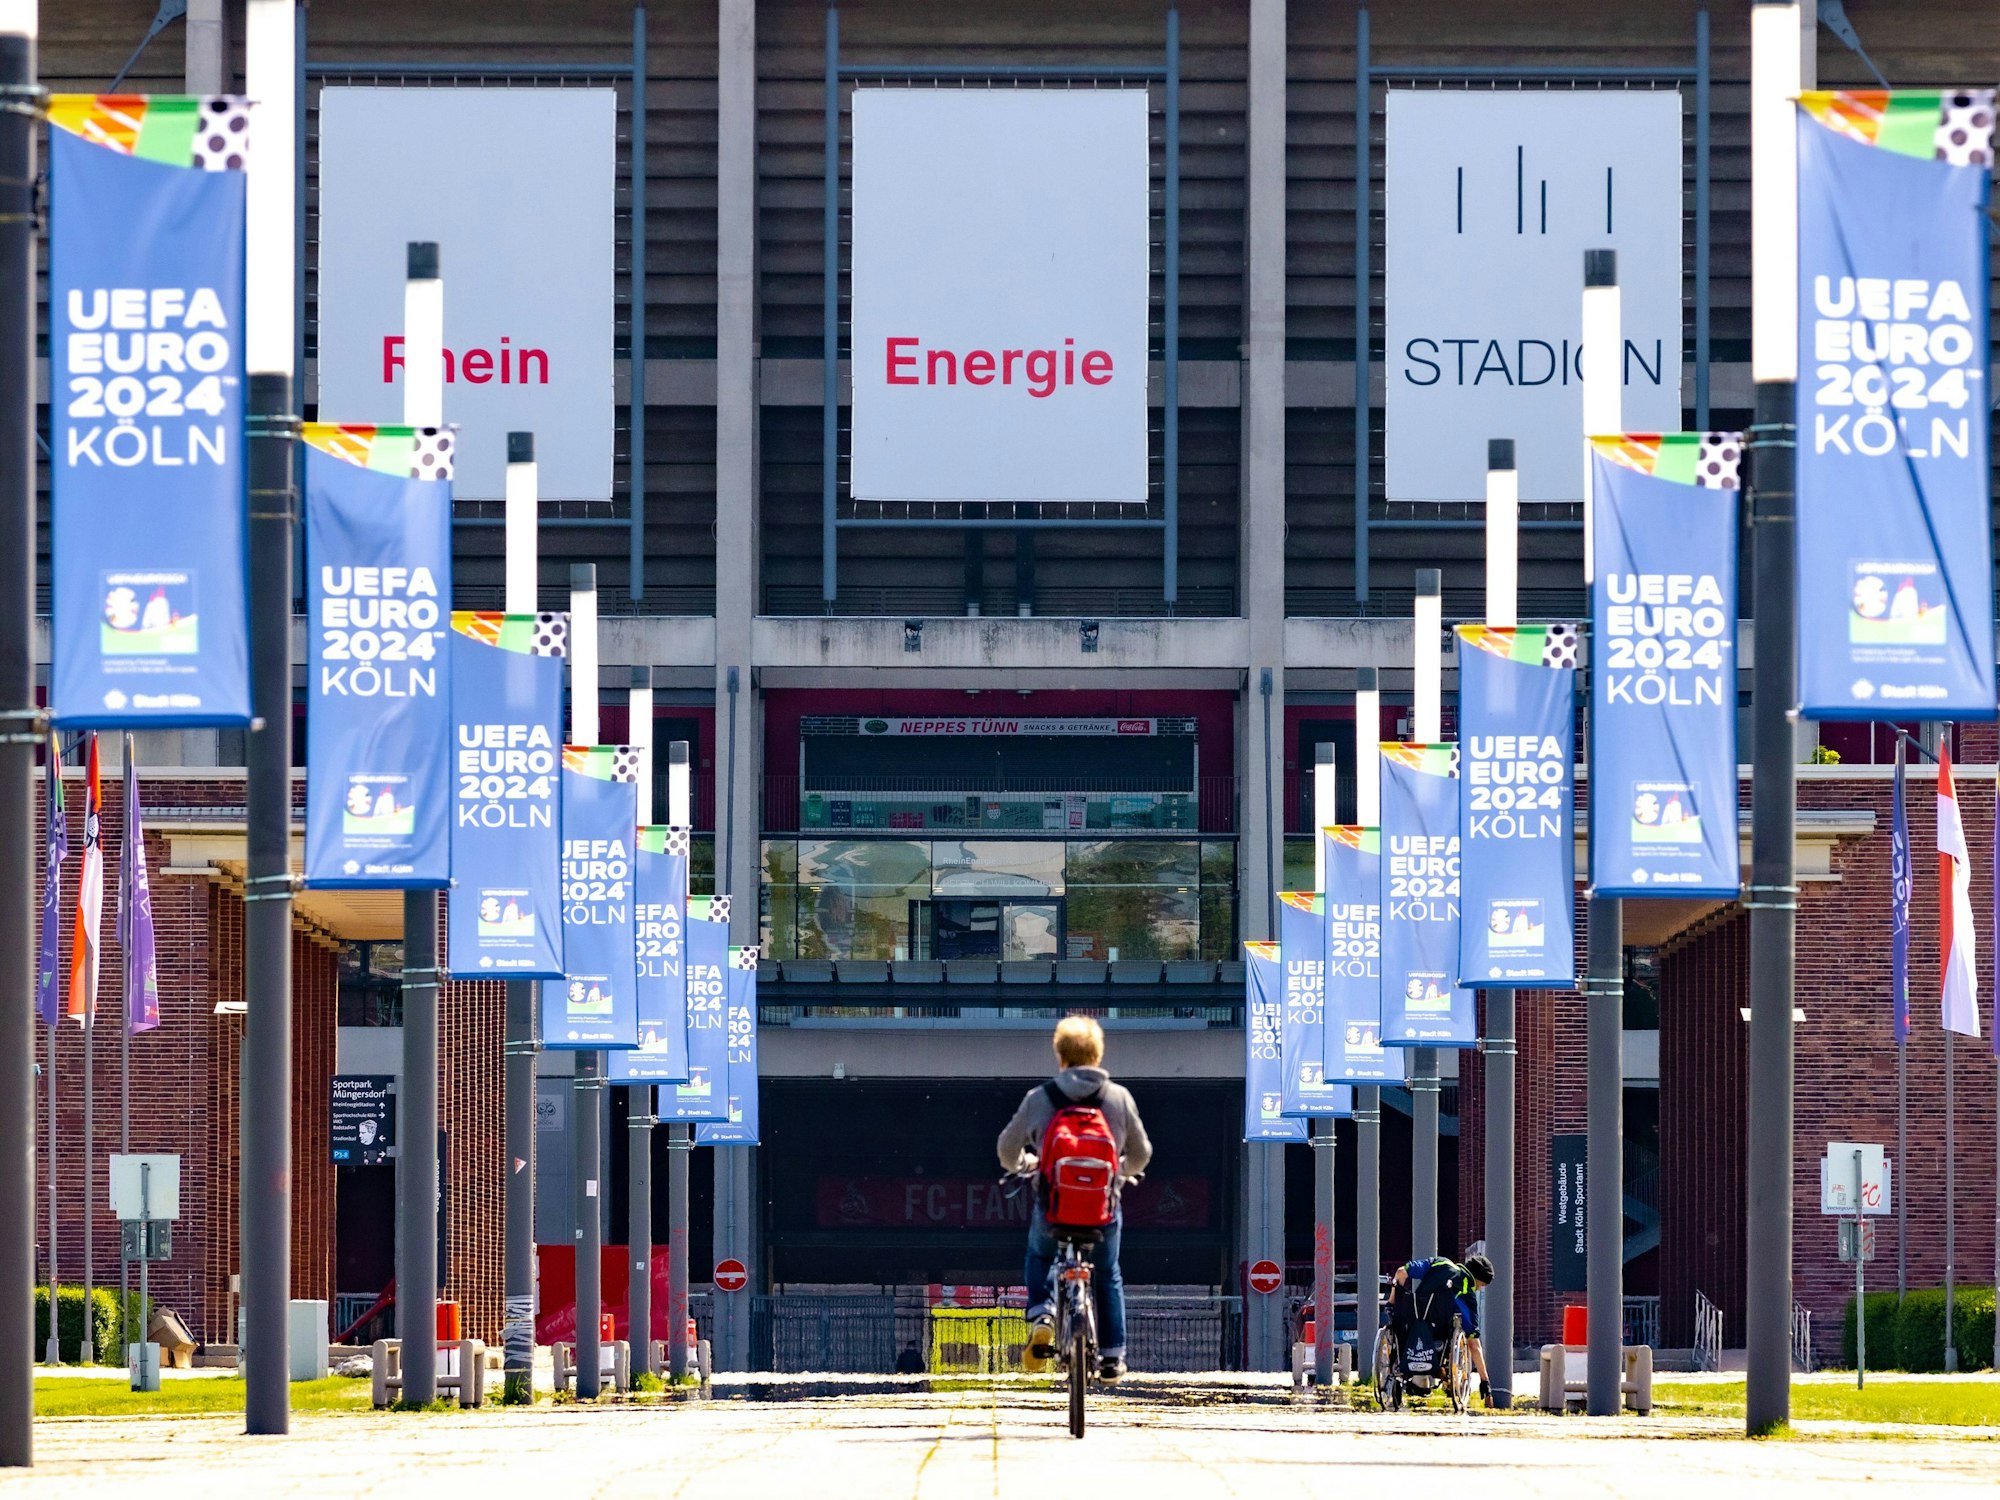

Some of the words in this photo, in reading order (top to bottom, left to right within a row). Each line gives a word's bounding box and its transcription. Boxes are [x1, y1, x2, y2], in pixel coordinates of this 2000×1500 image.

[68, 288, 227, 331] UEFA
[1815, 275, 1971, 321] UEFA
[68, 332, 230, 375] EURO
[1815, 319, 1973, 366] EURO
[886, 337, 1113, 398] Energie
[1405, 338, 1661, 386] STADIN
[68, 418, 226, 467] KÖLN
[1815, 406, 1969, 458] KÖLN
[322, 566, 438, 596] UEFA
[1607, 573, 1723, 605] UEFA
[322, 598, 439, 629] EURO
[1607, 606, 1725, 637] EURO
[322, 661, 436, 697] KÖLN
[1607, 669, 1722, 705] KÖLN
[459, 725, 552, 748] UEFA
[900, 721, 966, 733] NEPPES
[972, 718, 1019, 733] TÜNN
[1067, 722, 1110, 731] GETRÄNKE
[1470, 736, 1563, 759] UEFA
[459, 750, 553, 774] EURO
[1470, 761, 1564, 784] EURO
[459, 800, 551, 828] KÖLN
[1470, 811, 1561, 838] KÖLN
[1390, 836, 1460, 856] UEFA
[1390, 857, 1460, 877] EURO
[636, 904, 679, 921] EFA
[1332, 904, 1380, 921] UEF
[1390, 897, 1460, 921] KÖLN
[1332, 921, 1380, 940] EUR
[1332, 940, 1380, 957] 202
[1332, 957, 1379, 977] KÖL
[333, 1080, 372, 1090] Sportpark
[333, 1090, 386, 1100] Müngersdorf
[1558, 1162, 1568, 1225] Westgebäude
[1575, 1163, 1585, 1205] Sportamt
[1575, 1209, 1584, 1227] Köln
[1575, 1229, 1584, 1254] Stadt
